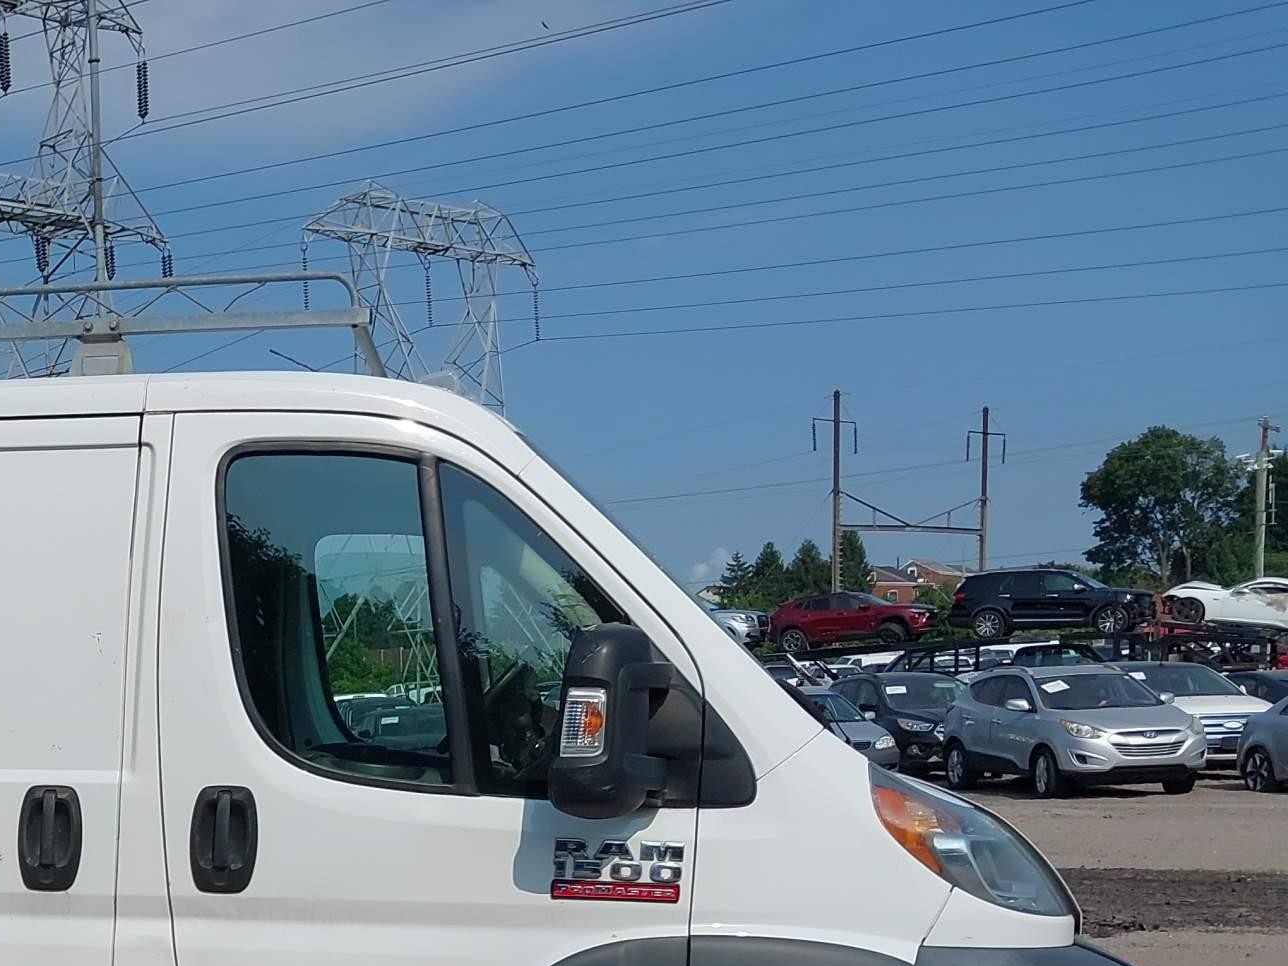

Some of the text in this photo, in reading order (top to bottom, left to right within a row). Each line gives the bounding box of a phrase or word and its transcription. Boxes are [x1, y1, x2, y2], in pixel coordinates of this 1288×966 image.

[554, 837, 685, 862] RAM
[554, 859, 682, 883] 1500
[555, 883, 676, 898] PROMASTER
